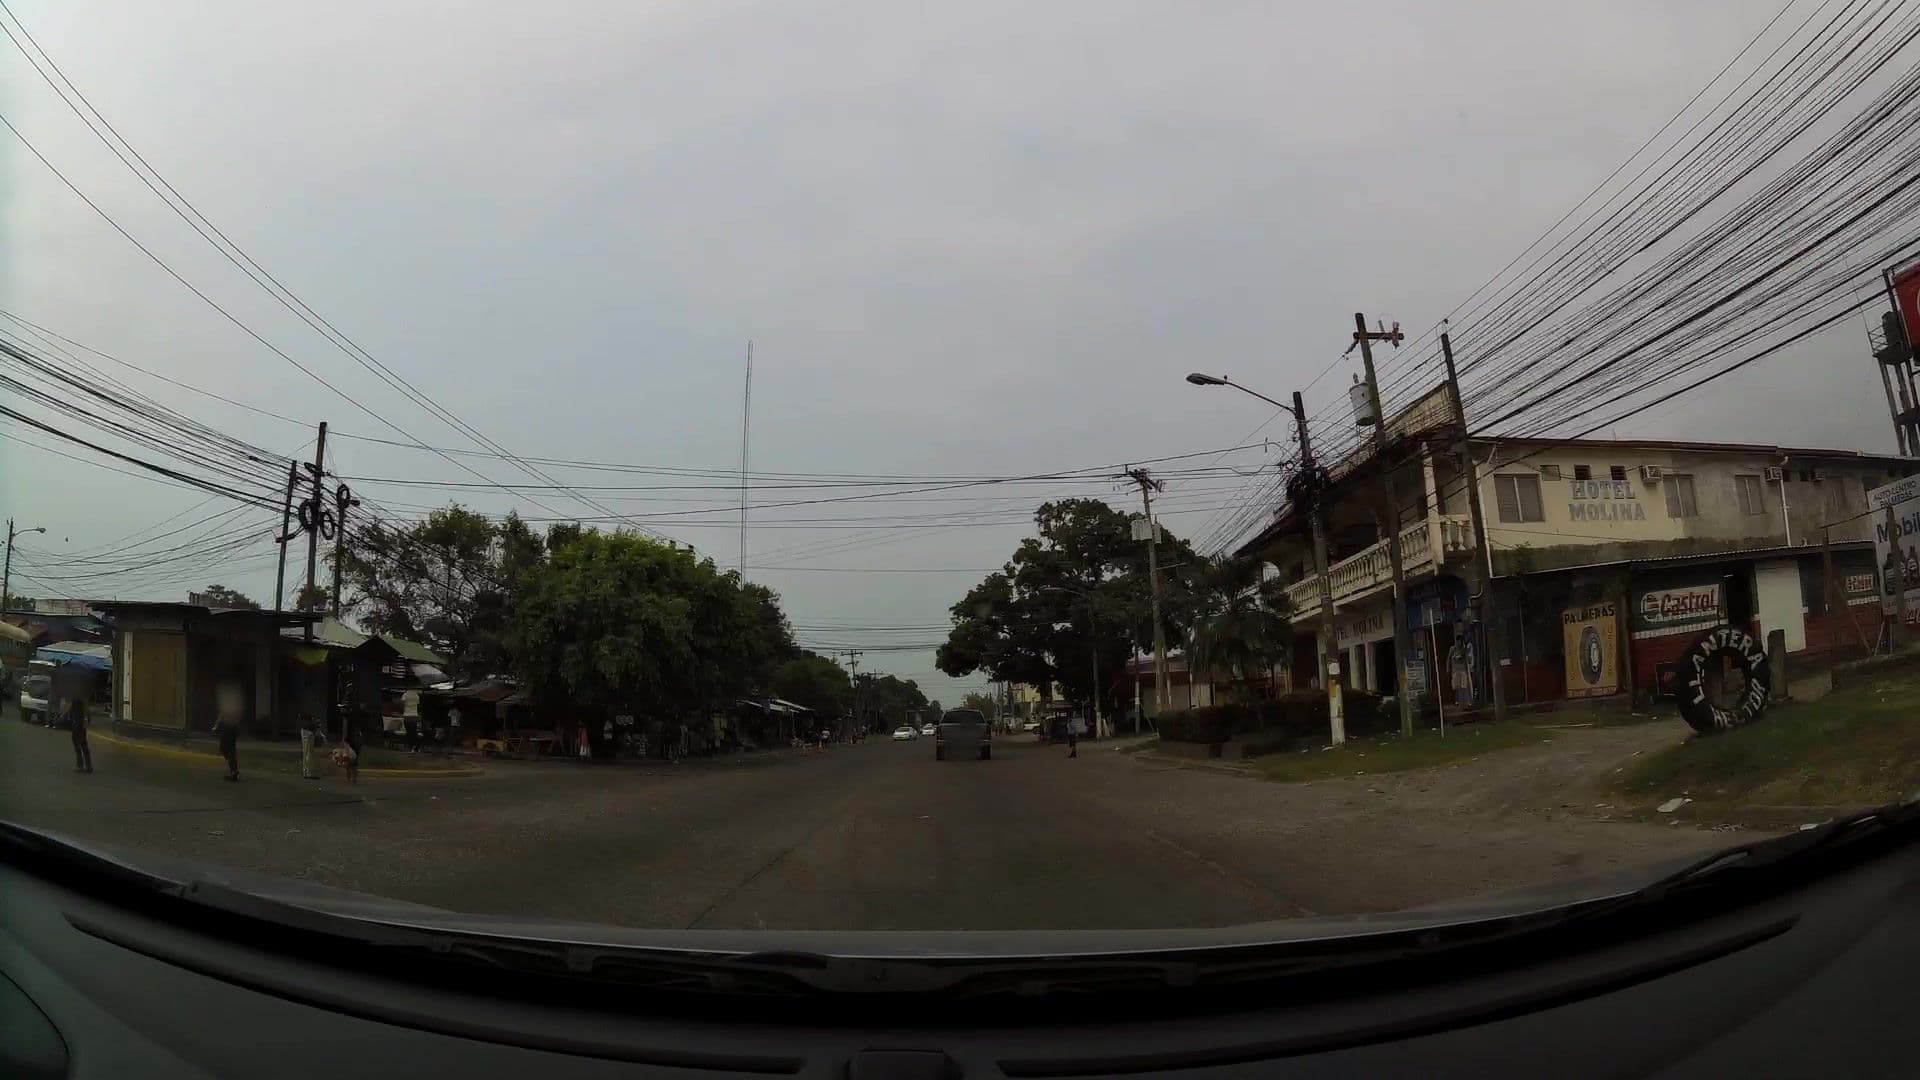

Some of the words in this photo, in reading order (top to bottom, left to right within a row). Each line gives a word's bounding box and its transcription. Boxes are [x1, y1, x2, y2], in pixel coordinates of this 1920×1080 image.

[1569, 480, 1636, 500] HOTEL
[1568, 503, 1648, 521] MOLINA
[1662, 588, 1716, 617] Castrol
[1564, 605, 1615, 625] PALMERAS
[1688, 628, 1764, 704] LLANTERA
